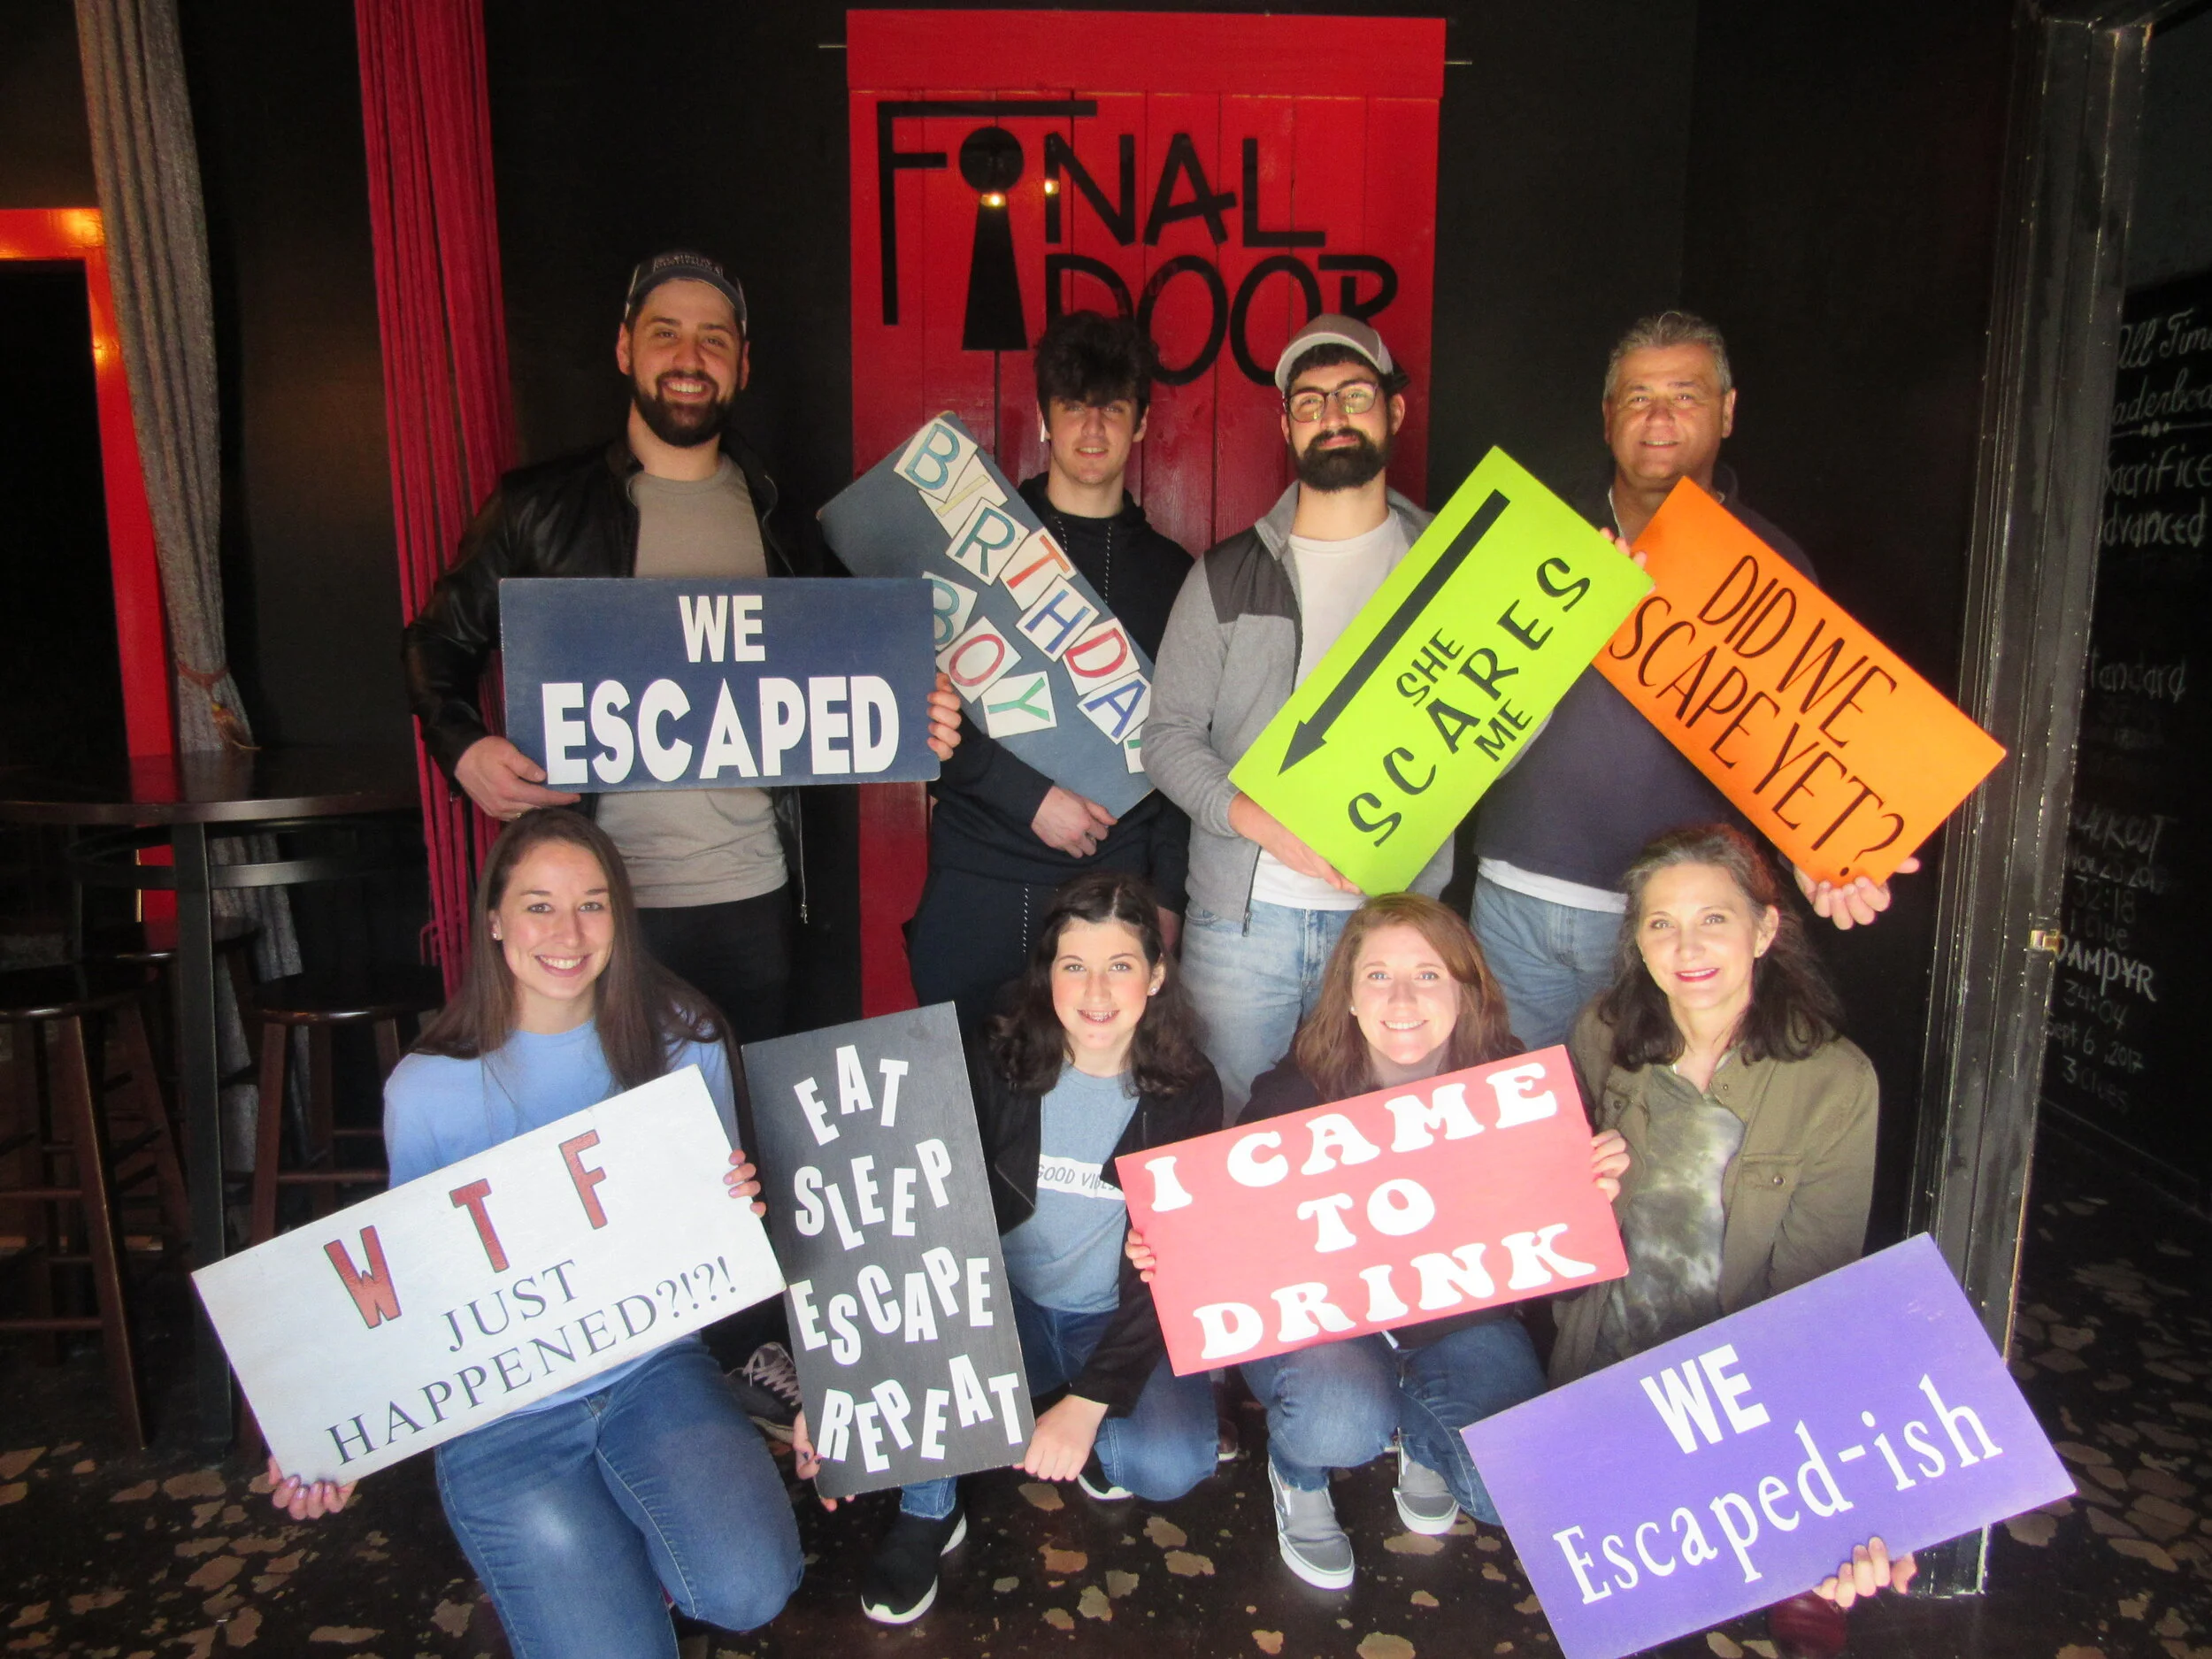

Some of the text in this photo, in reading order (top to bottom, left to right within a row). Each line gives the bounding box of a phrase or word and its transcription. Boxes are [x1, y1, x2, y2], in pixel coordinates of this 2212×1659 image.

[2102, 496, 2208, 549] dvanced
[679, 595, 765, 663] WE
[904, 422, 1148, 749] BIRTHDA
[933, 580, 1051, 722] BOY
[1348, 557, 1590, 847] SCARES
[1396, 628, 1464, 707] SHE
[1697, 555, 1897, 749] DID WE
[2089, 644, 2188, 704] tandard
[541, 676, 899, 784] ESCAPED
[1473, 699, 1533, 762] ME
[1609, 596, 1905, 877] SCAPE YET?
[794, 1044, 909, 1146] EAT
[1144, 1063, 1557, 1212] I CAME
[795, 1138, 952, 1250] SLEEP
[1297, 1178, 1435, 1253] TO
[440, 1259, 580, 1352] JUST
[789, 1247, 993, 1365] ESCAPE
[1193, 1223, 1596, 1359] DRINK
[325, 1256, 737, 1466] HAPPENED?!?!
[817, 1354, 1023, 1472] REPEAT
[1640, 1343, 1770, 1455] WE
[1553, 1374, 2003, 1605] Escaped-ish
